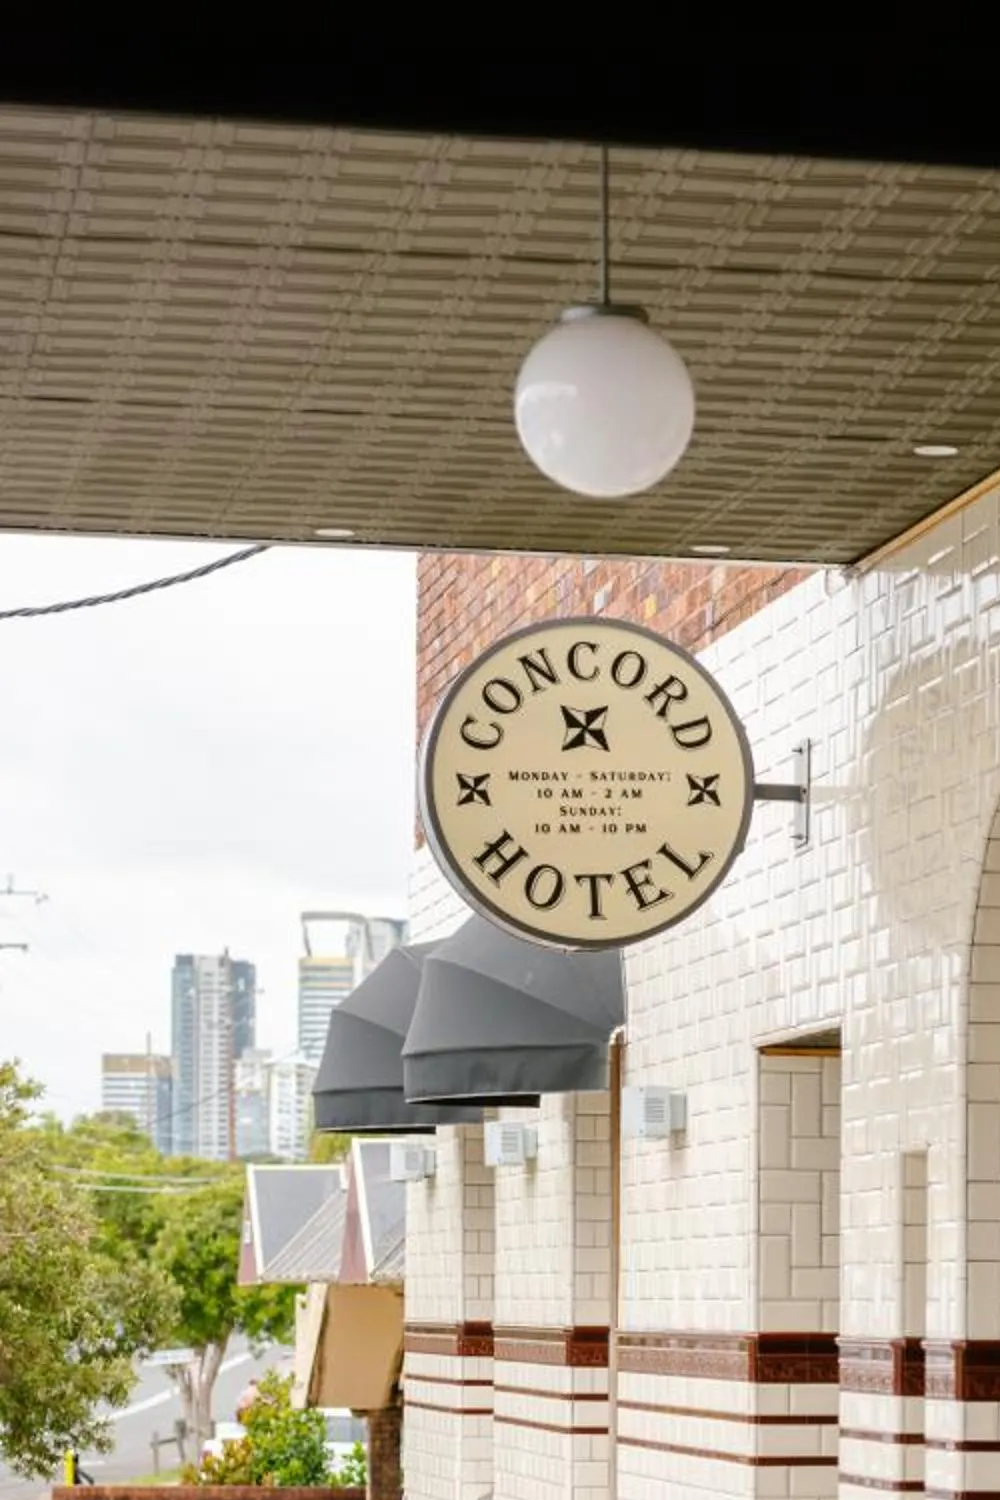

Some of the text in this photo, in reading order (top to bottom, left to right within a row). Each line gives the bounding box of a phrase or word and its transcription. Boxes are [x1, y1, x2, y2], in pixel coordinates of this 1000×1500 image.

[459, 641, 713, 751] CONCORD
[508, 770, 569, 782] MONDAY
[590, 771, 672, 782] SATURDAY:
[537, 788, 553, 799] 10
[561, 788, 583, 799] AM
[604, 788, 612, 799] 2
[621, 788, 643, 799] AM
[559, 805, 622, 817] SUNDAY:
[535, 823, 551, 834] 10
[558, 823, 581, 834] AM
[603, 823, 618, 834] 10
[625, 823, 648, 834] PM
[472, 829, 714, 921] HOTEL
